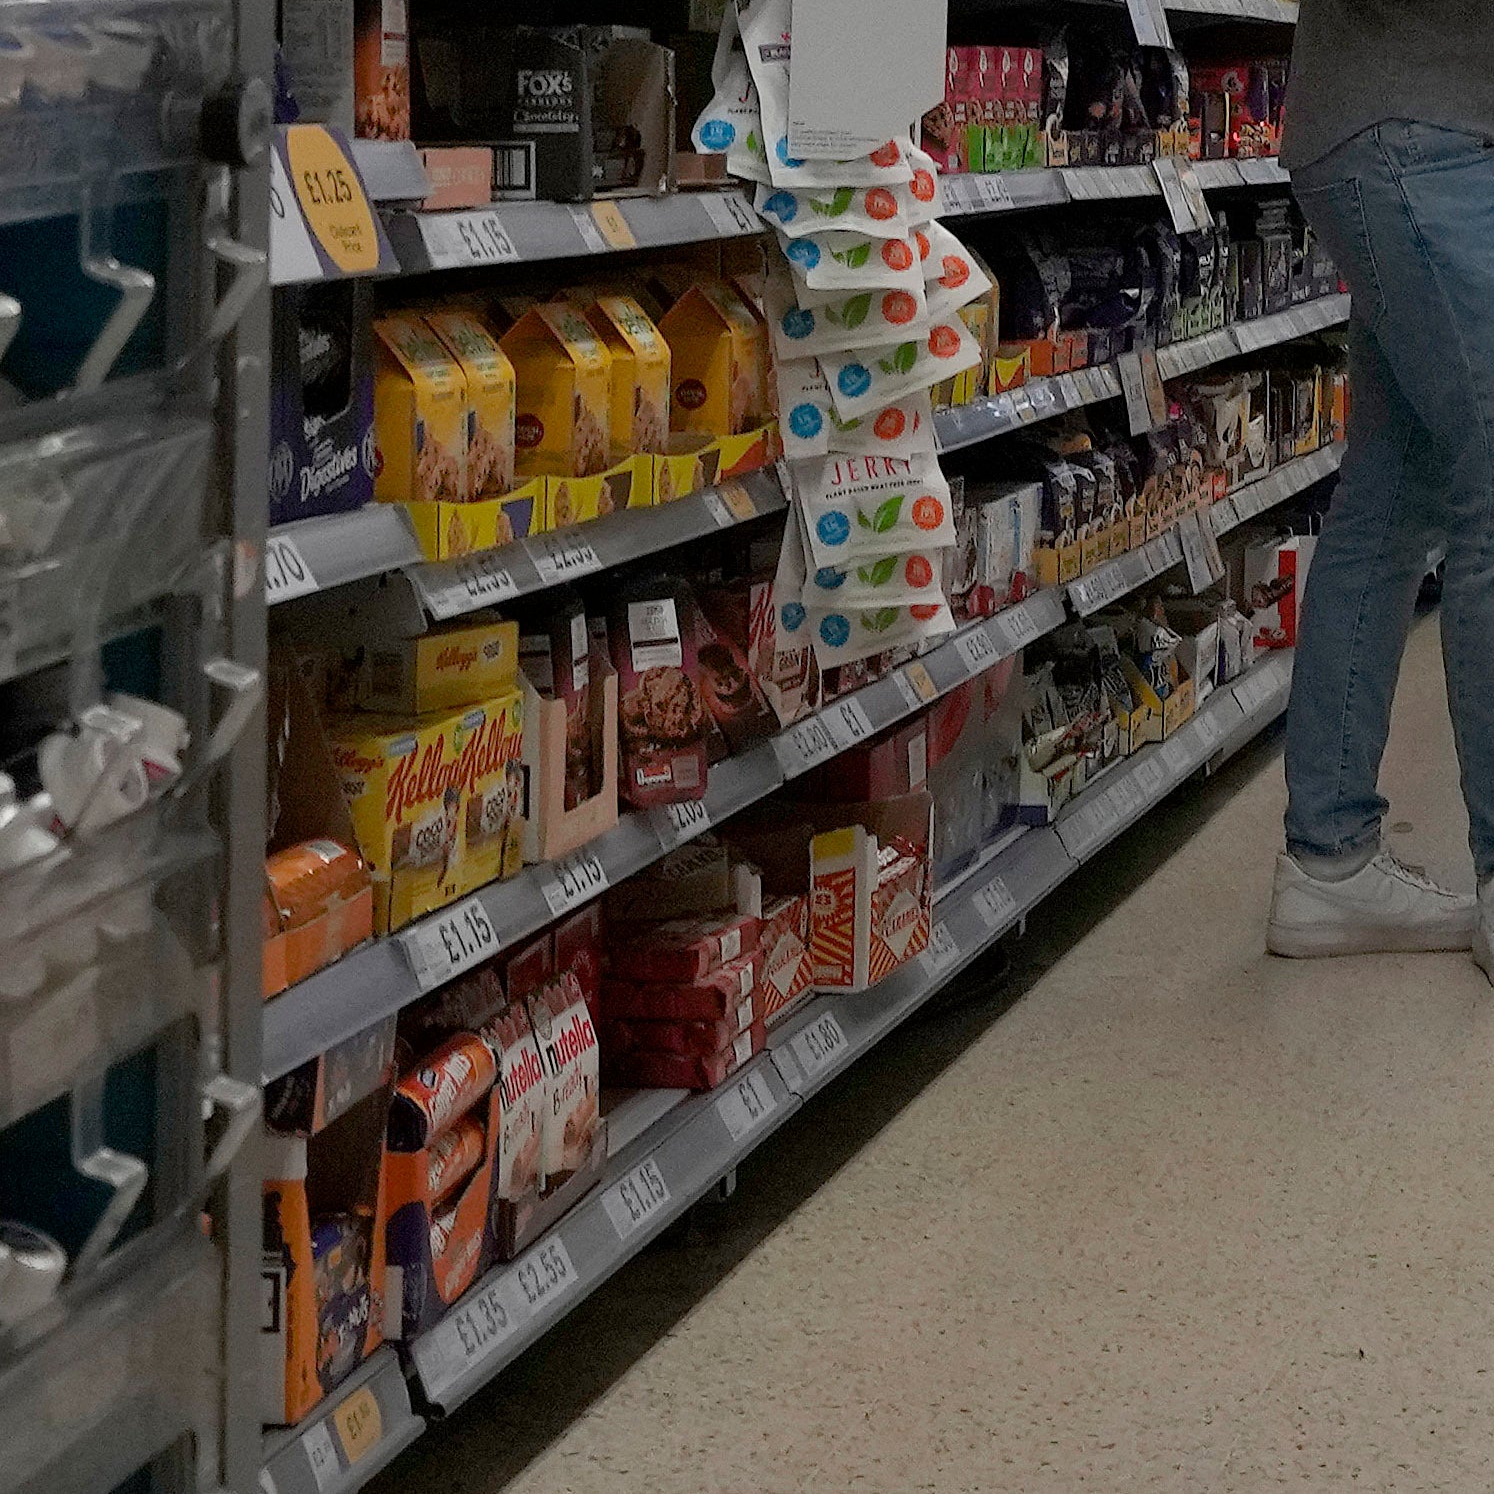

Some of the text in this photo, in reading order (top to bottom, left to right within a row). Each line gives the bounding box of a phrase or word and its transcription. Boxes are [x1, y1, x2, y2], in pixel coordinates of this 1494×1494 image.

[304, 169, 353, 204] £1.25
[831, 456, 911, 485] JERKY
[439, 908, 493, 963] £1.15
[546, 1014, 597, 1075] nutella
[805, 1020, 841, 1063] £1.80
[499, 1047, 543, 1112] nutella
[741, 1080, 763, 1119] £1
[620, 1164, 666, 1222] £1.15
